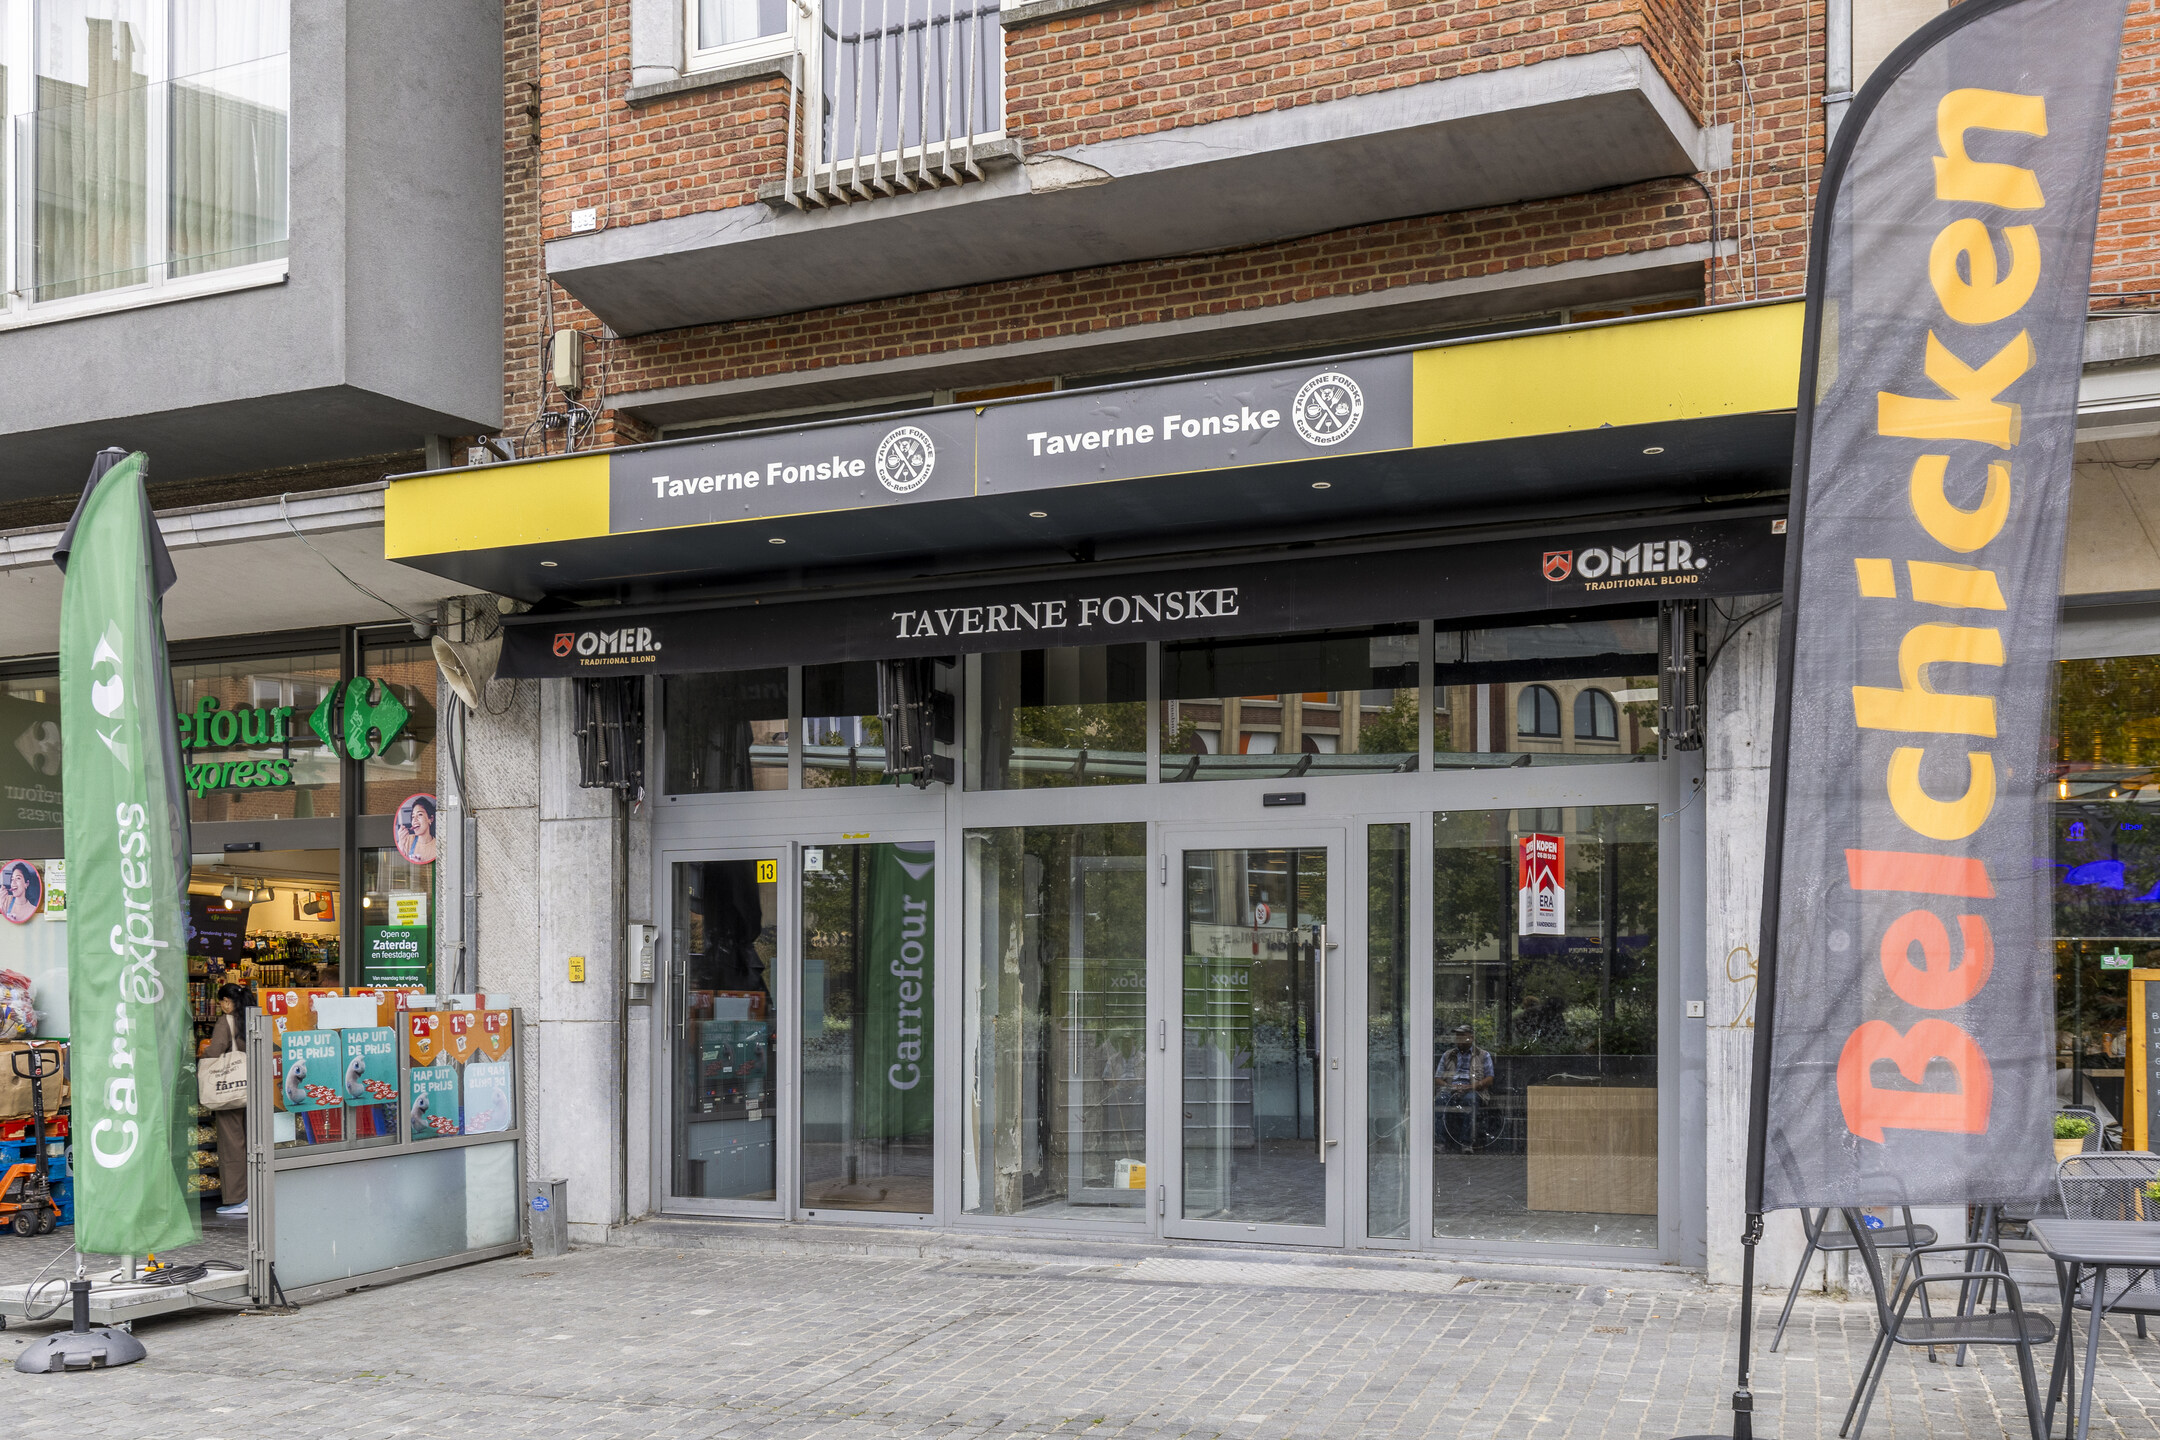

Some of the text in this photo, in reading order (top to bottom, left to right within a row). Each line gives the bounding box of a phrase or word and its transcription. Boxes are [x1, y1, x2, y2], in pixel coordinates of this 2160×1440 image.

[1295, 375, 1361, 414] TAVERNE FONSKE
[1027, 406, 1281, 457] Taverne Fonske
[1296, 412, 1360, 444] Café-Restaurant
[878, 429, 934, 464] TAVERNE FONSKE
[652, 456, 866, 499] Taverne Fonske
[1576, 540, 1708, 579] OMER.
[1584, 575, 1699, 592] TRADITIONAL BLOND
[891, 587, 1240, 639] TAVERNE FONSKE
[1836, 88, 2048, 1143] Belchicken
[576, 627, 662, 656] OMER.
[580, 655, 656, 666] TRADITIONAL BLOND
[2120, 823, 2143, 831] Uber
[1536, 840, 1558, 853] KOPEN
[760, 863, 774, 880] 13
[116, 802, 169, 1004] express
[1539, 894, 1554, 908] ERA
[380, 930, 410, 939] Open op
[373, 940, 418, 951] Zaterdag
[381, 951, 420, 960] feestdagen
[888, 893, 928, 1090] Carrefour
[413, 1017, 429, 1035] 2.00
[288, 1033, 331, 1047] HAP UIT
[348, 1031, 388, 1043] HAP UIT
[288, 1047, 335, 1060] DE PRIJS
[348, 1043, 391, 1056] DE PRIJS
[413, 1069, 450, 1081] HAP UIT
[413, 1081, 453, 1093] DE PRIJS
